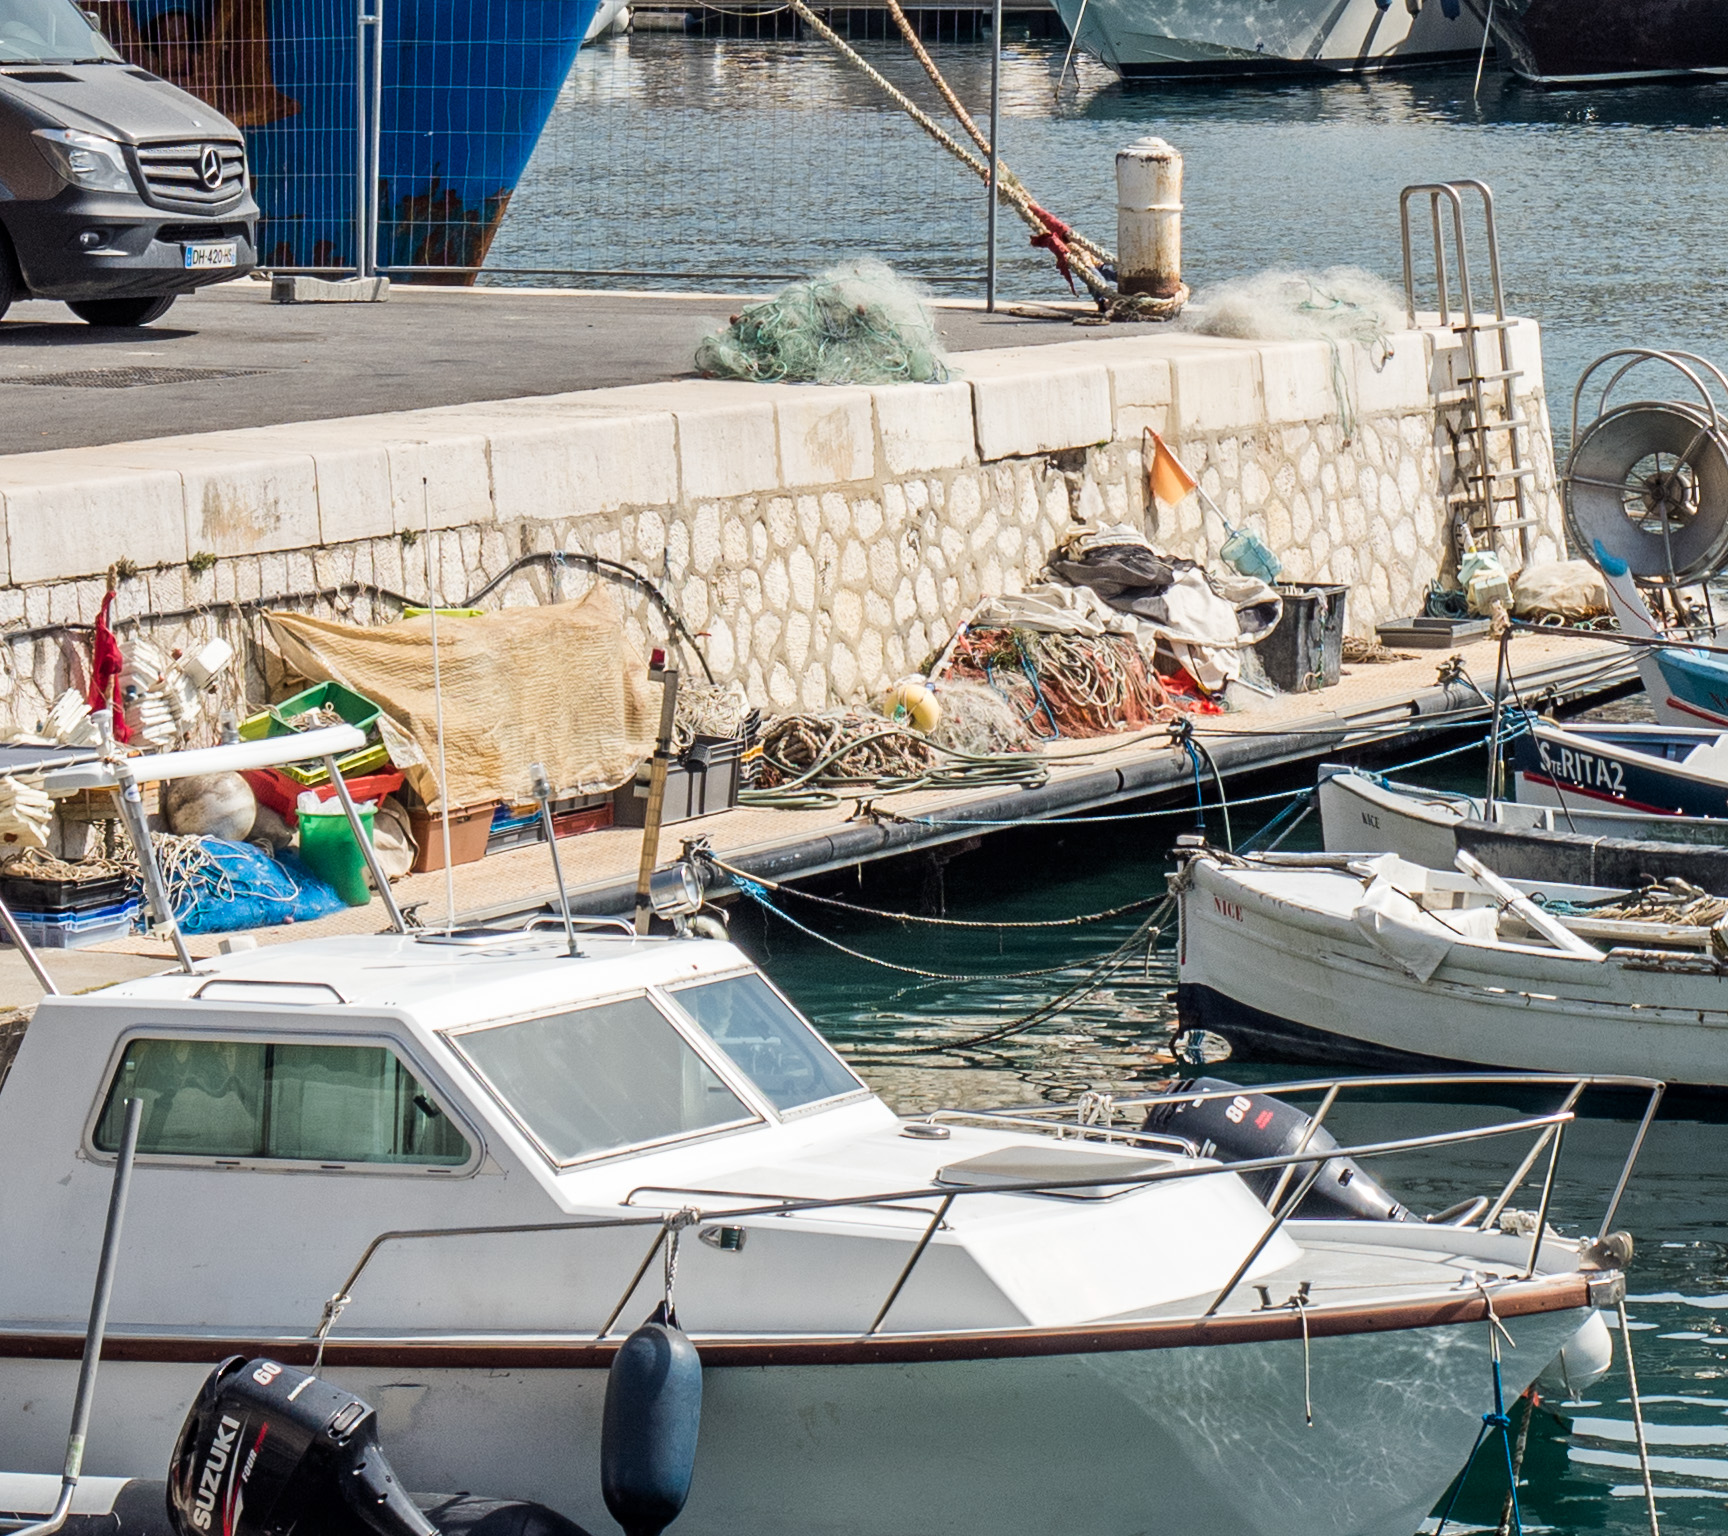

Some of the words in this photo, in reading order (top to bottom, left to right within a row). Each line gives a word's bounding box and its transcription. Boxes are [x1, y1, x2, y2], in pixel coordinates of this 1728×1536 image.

[1225, 1095, 1254, 1124] 80
[252, 1361, 282, 1387] 60
[193, 1414, 241, 1531] SUZUKI
